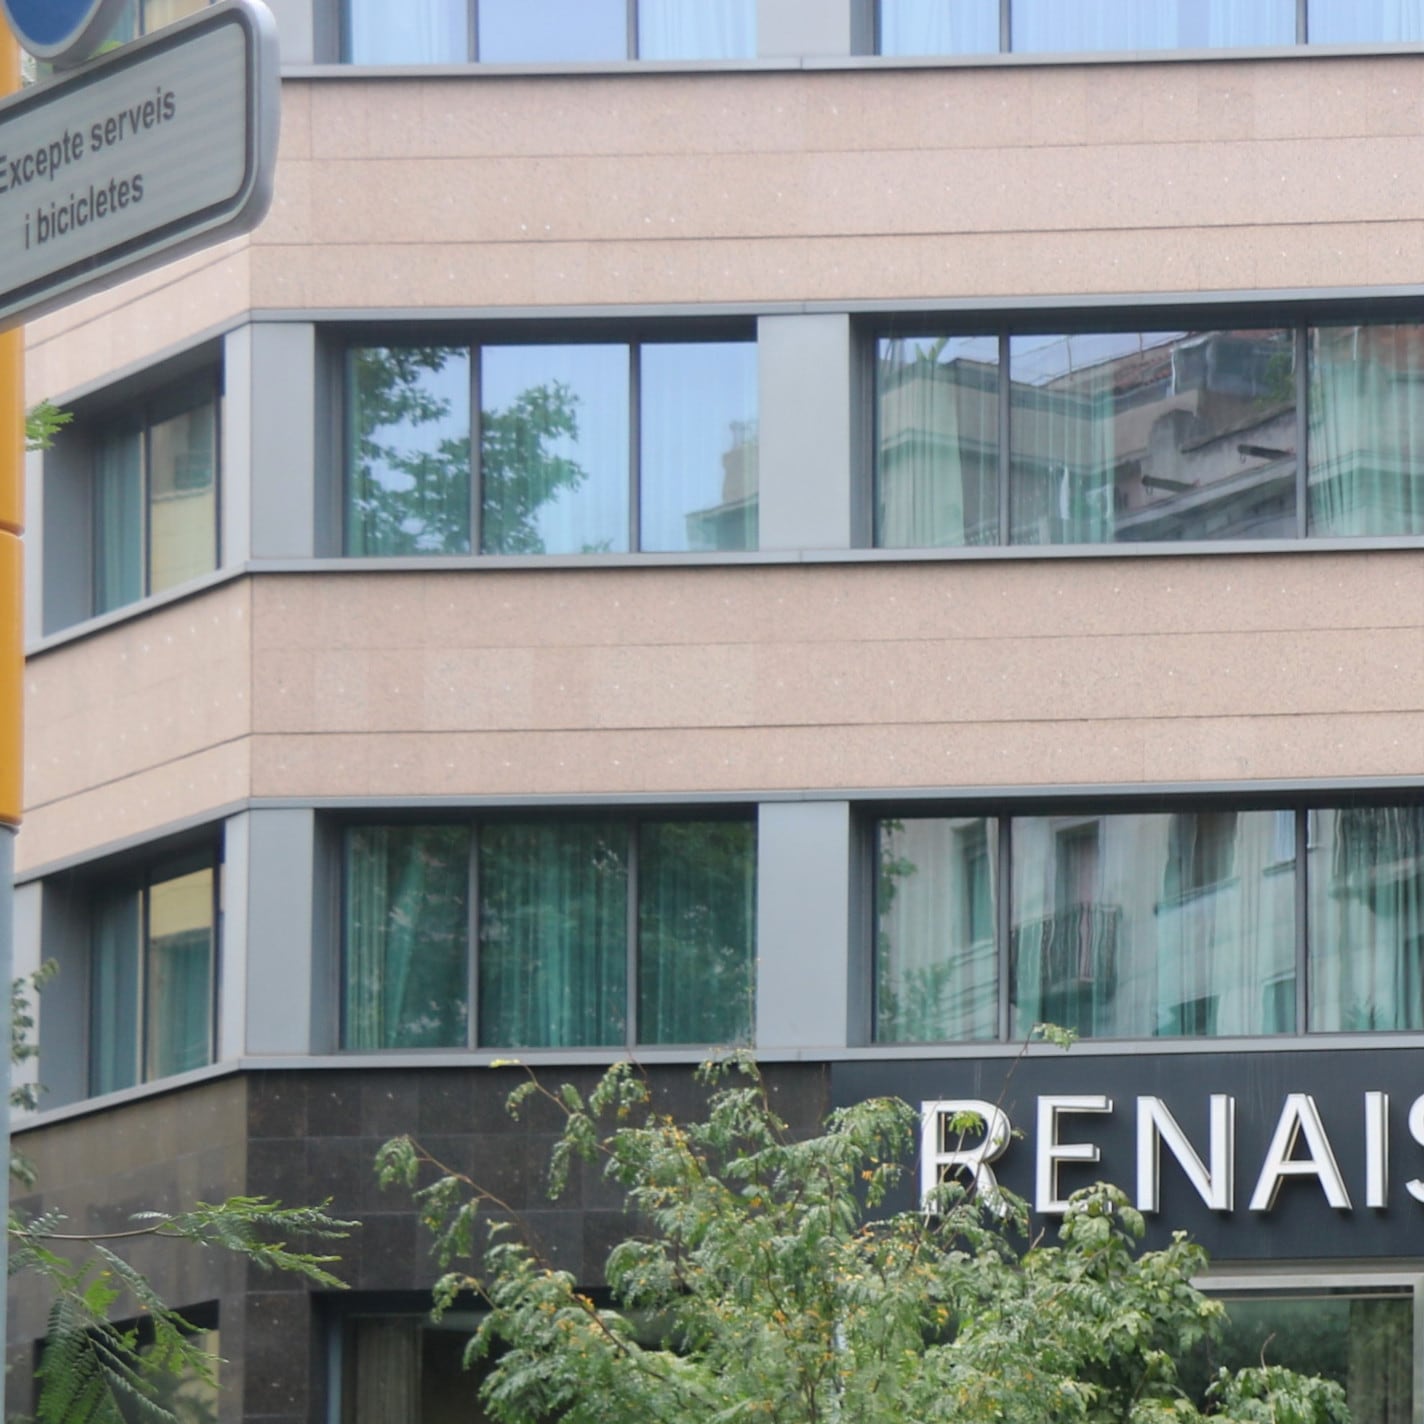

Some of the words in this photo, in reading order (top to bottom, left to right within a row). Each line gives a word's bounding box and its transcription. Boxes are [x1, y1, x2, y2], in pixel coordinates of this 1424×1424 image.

[0, 128, 84, 194] Excepte
[91, 87, 175, 151] serveis
[25, 213, 30, 250] i
[38, 174, 143, 244] bicicletes
